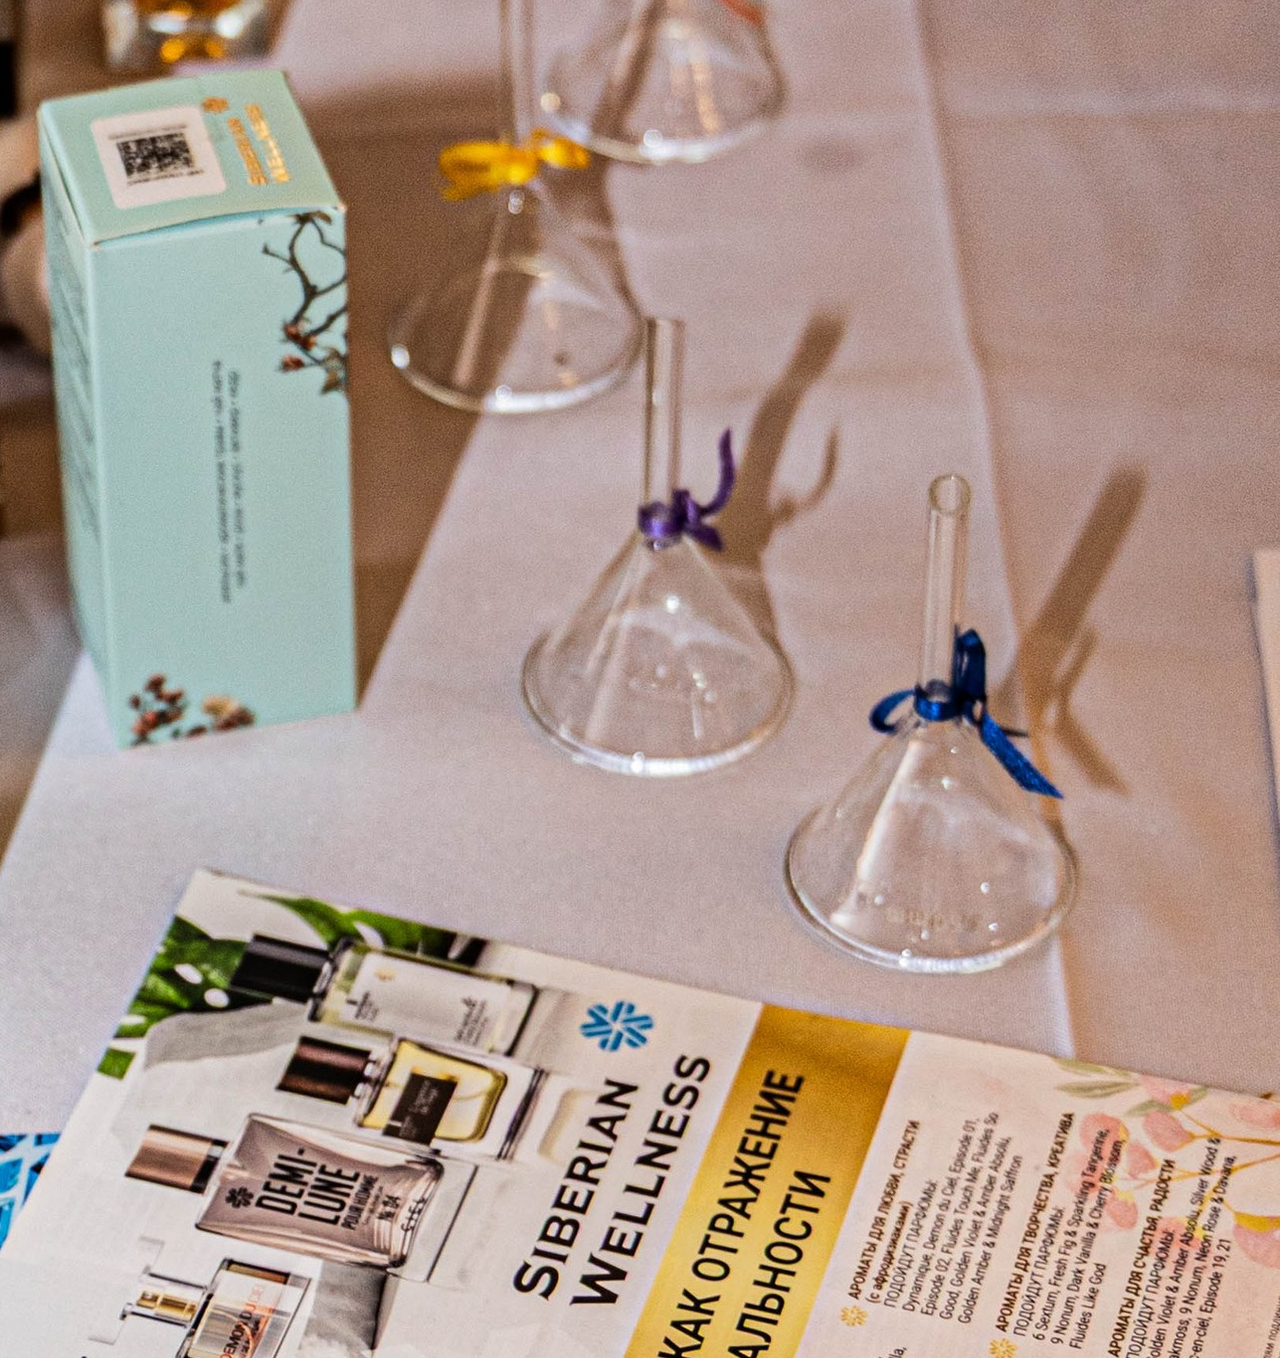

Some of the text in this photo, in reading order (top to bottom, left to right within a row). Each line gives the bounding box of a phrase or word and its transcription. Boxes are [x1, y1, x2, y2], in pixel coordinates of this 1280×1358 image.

[255, 1148, 318, 1216] DEMI-
[298, 1164, 361, 1227] LUNE
[511, 1077, 639, 1300] SIBERIAN
[569, 1054, 711, 1306] WELLNESS
[690, 1069, 805, 1283] ОТРАЖЕНИЕ
[847, 1120, 919, 1300] АРОМАТЫ ДЛЯ ЛЮБВИ, СТРАСТИ
[995, 1112, 1074, 1332] АРОМАТЫ ДЛЯ ТВОРЧЕСТВА, КРЕАТИВА
[1107, 1158, 1175, 1358] АРОМАТЫ ДЛЯ СЧАСТЬЯ, РАДОСТИ
